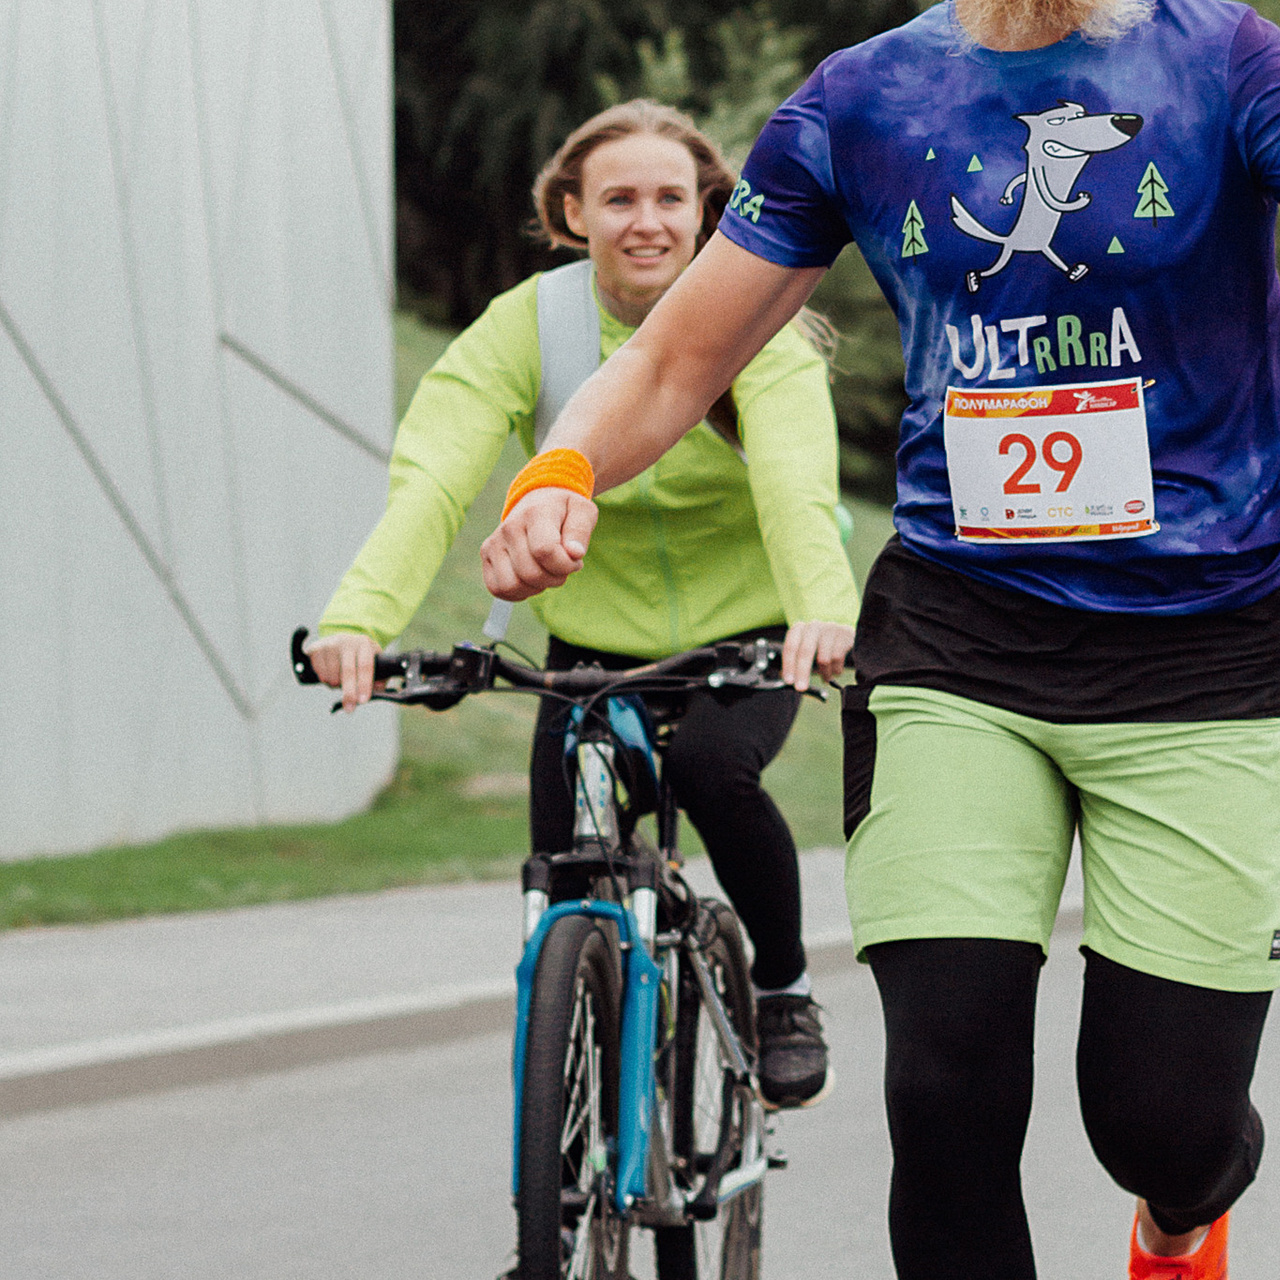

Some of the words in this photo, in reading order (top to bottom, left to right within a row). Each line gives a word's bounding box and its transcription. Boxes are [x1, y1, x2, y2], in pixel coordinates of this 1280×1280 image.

[945, 307, 1142, 381] ULTRRRA
[953, 396, 1049, 411] ПОЛУМАРАФОН
[997, 430, 1083, 495] 29
